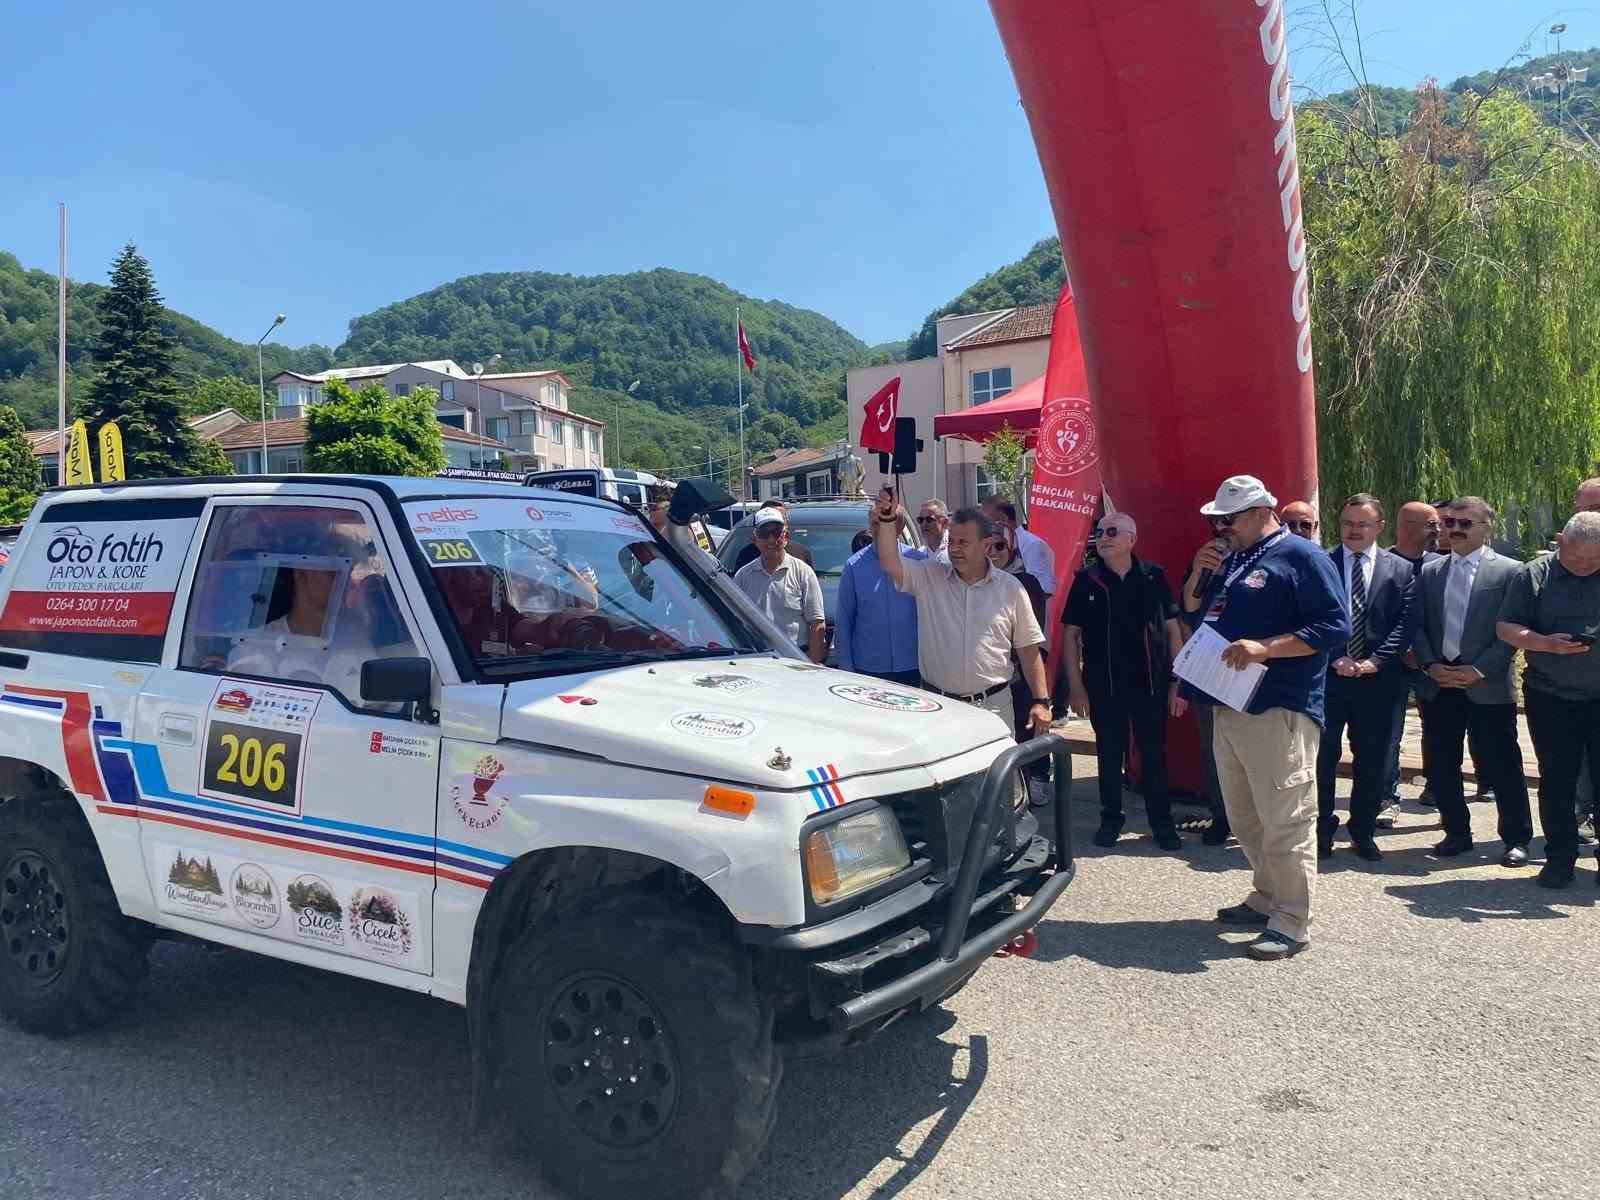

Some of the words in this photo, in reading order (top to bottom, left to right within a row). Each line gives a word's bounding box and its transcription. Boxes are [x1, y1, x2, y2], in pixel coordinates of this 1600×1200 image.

[1082, 493, 1097, 504] VE
[47, 536, 93, 563] Oto
[97, 531, 163, 563] fatih
[428, 542, 473, 560] 206
[49, 565, 95, 580] JAPON
[97, 565, 108, 579] &
[112, 565, 149, 579] KORE
[46, 598, 74, 611] 0264
[75, 598, 98, 611] 300
[100, 599, 114, 611] 17
[114, 599, 130, 611] 04
[28, 615, 138, 629] www.japonotofatih.com
[216, 734, 286, 792] 206
